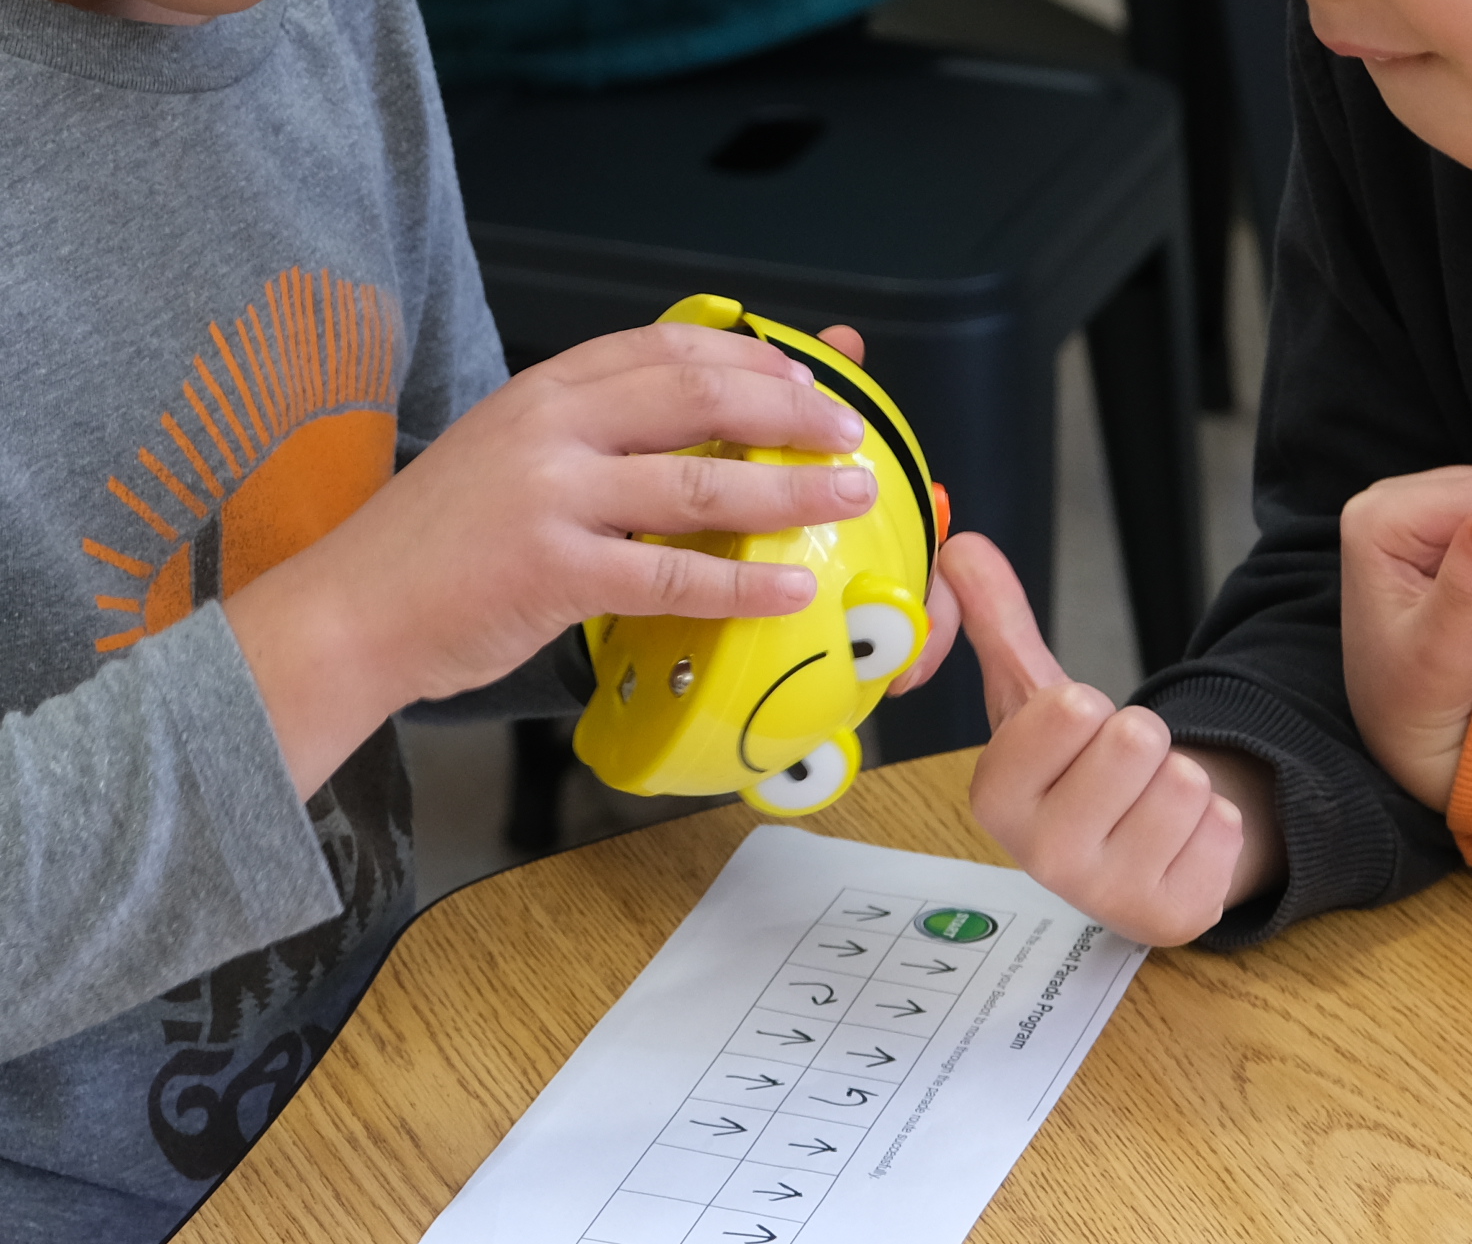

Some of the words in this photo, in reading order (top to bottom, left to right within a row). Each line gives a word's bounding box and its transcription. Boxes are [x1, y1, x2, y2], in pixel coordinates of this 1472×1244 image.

[943, 913, 970, 939] START
[1013, 946, 1032, 963] code
[1064, 924, 1104, 962] BeeBot
[996, 972, 1013, 990] your
[1007, 963, 1024, 973] for
[1040, 963, 1079, 1001] Parade
[959, 1025, 980, 1045] move
[1009, 1002, 1054, 1051] Program
[940, 1045, 969, 1074] through
[932, 1074, 951, 1086] the
[914, 1086, 940, 1113] parade
[901, 1113, 922, 1133] route
[868, 1133, 908, 1181] successfully.
